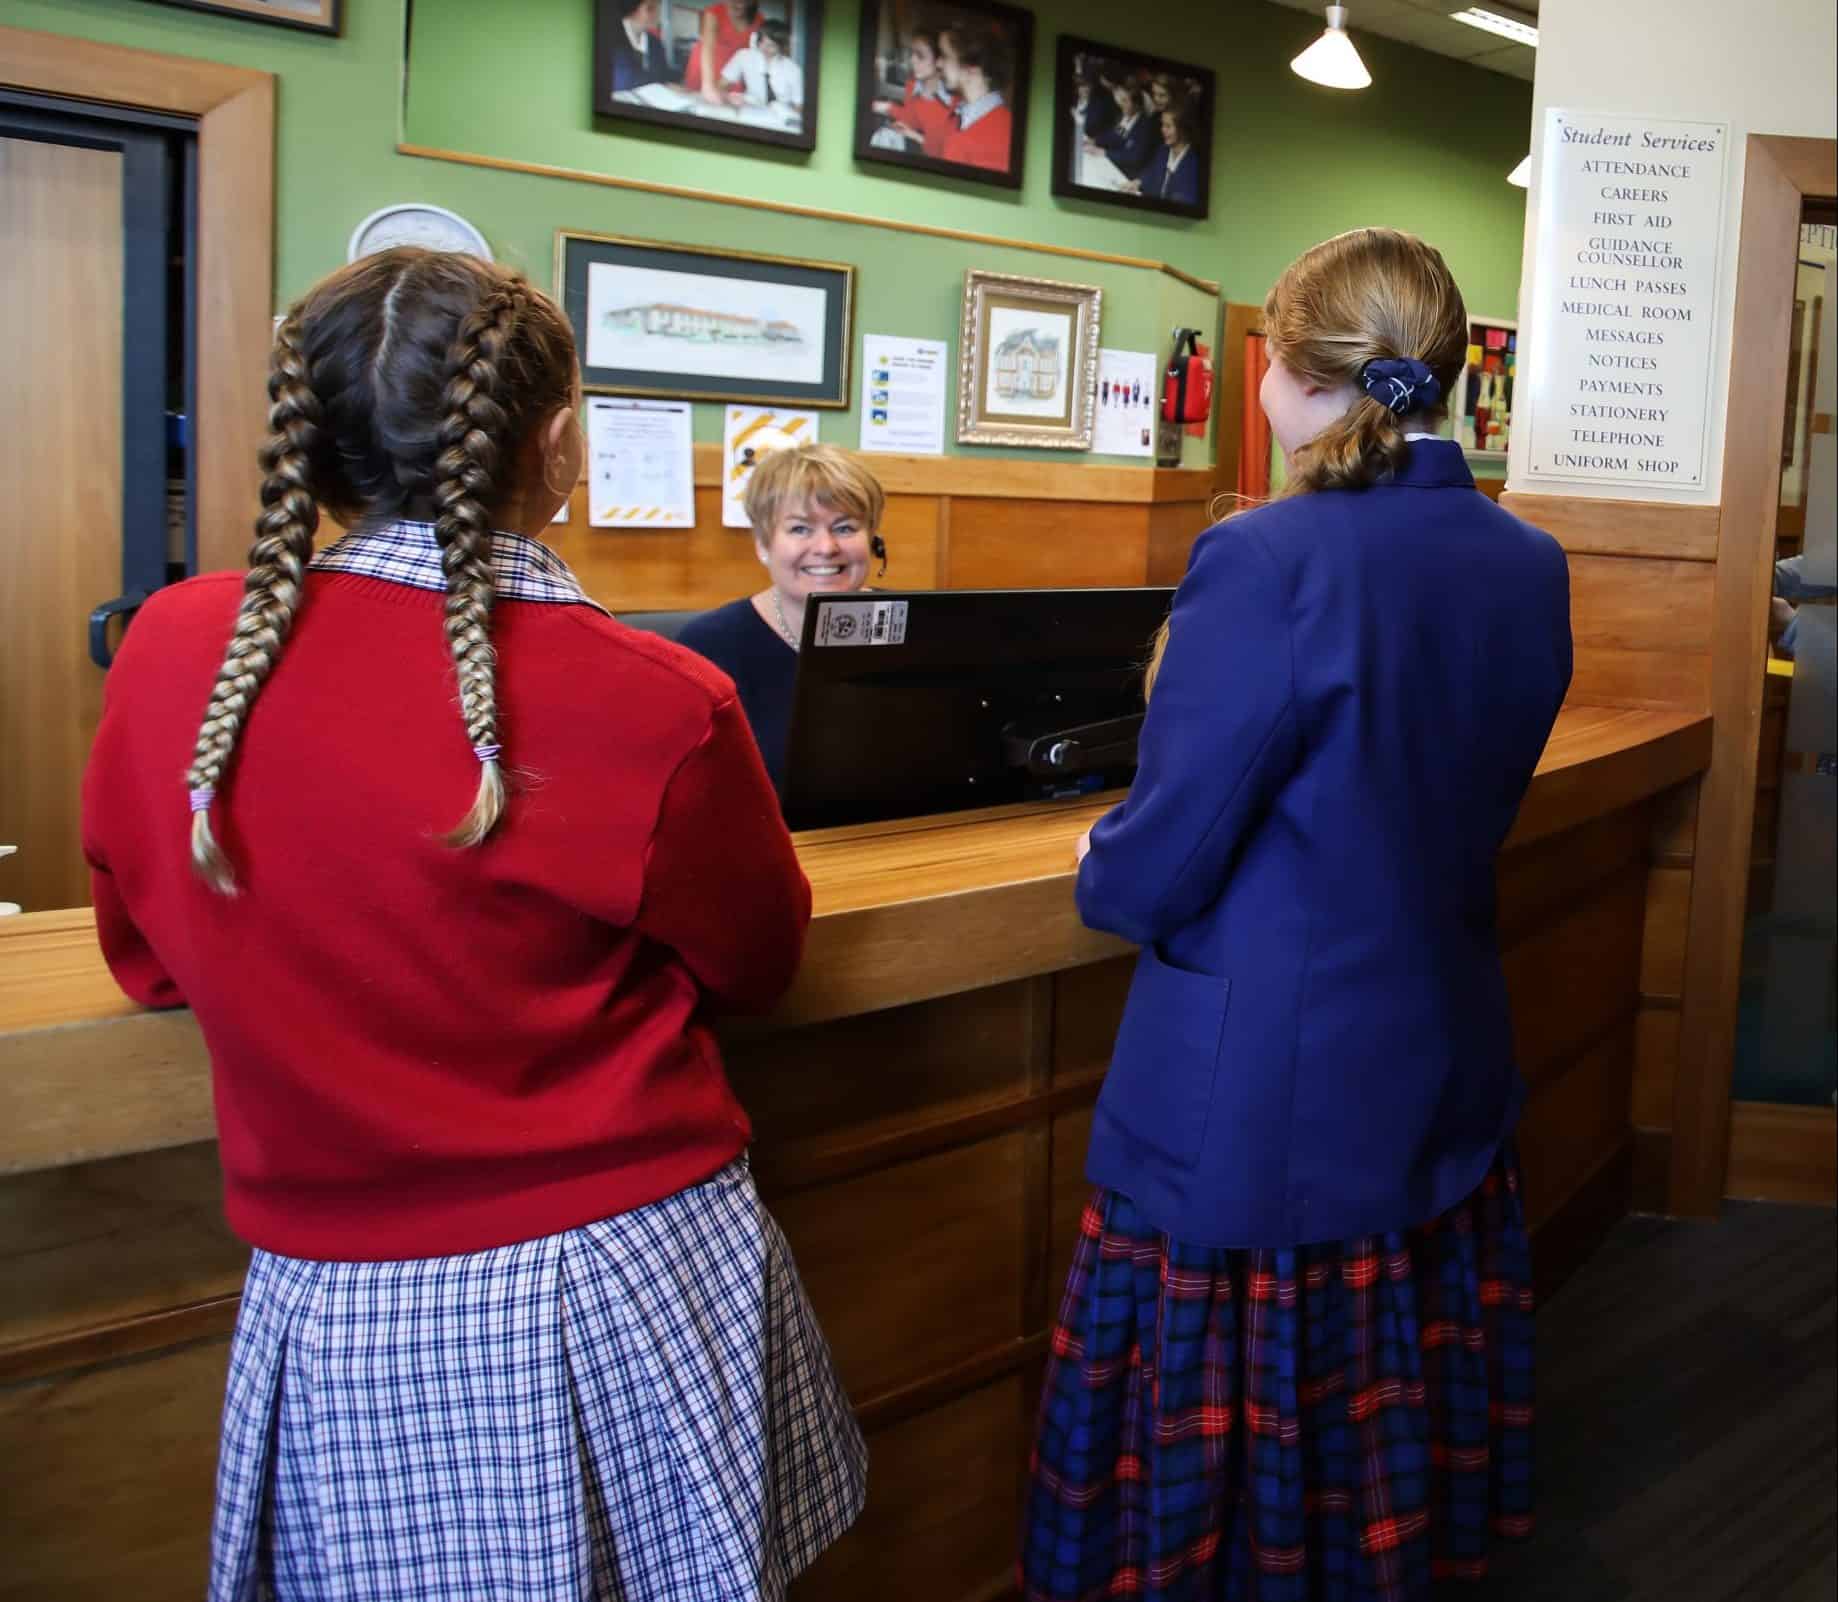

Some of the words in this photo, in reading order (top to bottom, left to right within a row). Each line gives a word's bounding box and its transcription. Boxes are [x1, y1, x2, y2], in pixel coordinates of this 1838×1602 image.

[1561, 127, 1632, 146] Student
[1641, 131, 1715, 151] Services
[1582, 160, 1691, 178] ATTENDANCE
[1601, 187, 1668, 202] CAREERS
[1593, 211, 1635, 226] FIRST
[1643, 215, 1672, 229] AID
[1589, 237, 1673, 255] GUIDANCE
[1577, 251, 1683, 269] COUNSELLOR
[1570, 276, 1626, 291] LUNCH
[1636, 280, 1686, 295] PASSES
[1561, 302, 1632, 317] MEDICAL
[1641, 307, 1691, 321] ROOM
[1585, 328, 1664, 344] MESSAGES
[1589, 354, 1657, 369] NOTICES
[1580, 379, 1663, 396] PAYMENTS
[1569, 404, 1669, 422] STATIONERY
[1572, 429, 1664, 447] TELEPHONE
[1553, 454, 1628, 470] UNIFORM
[1637, 459, 1679, 473] SHOP
